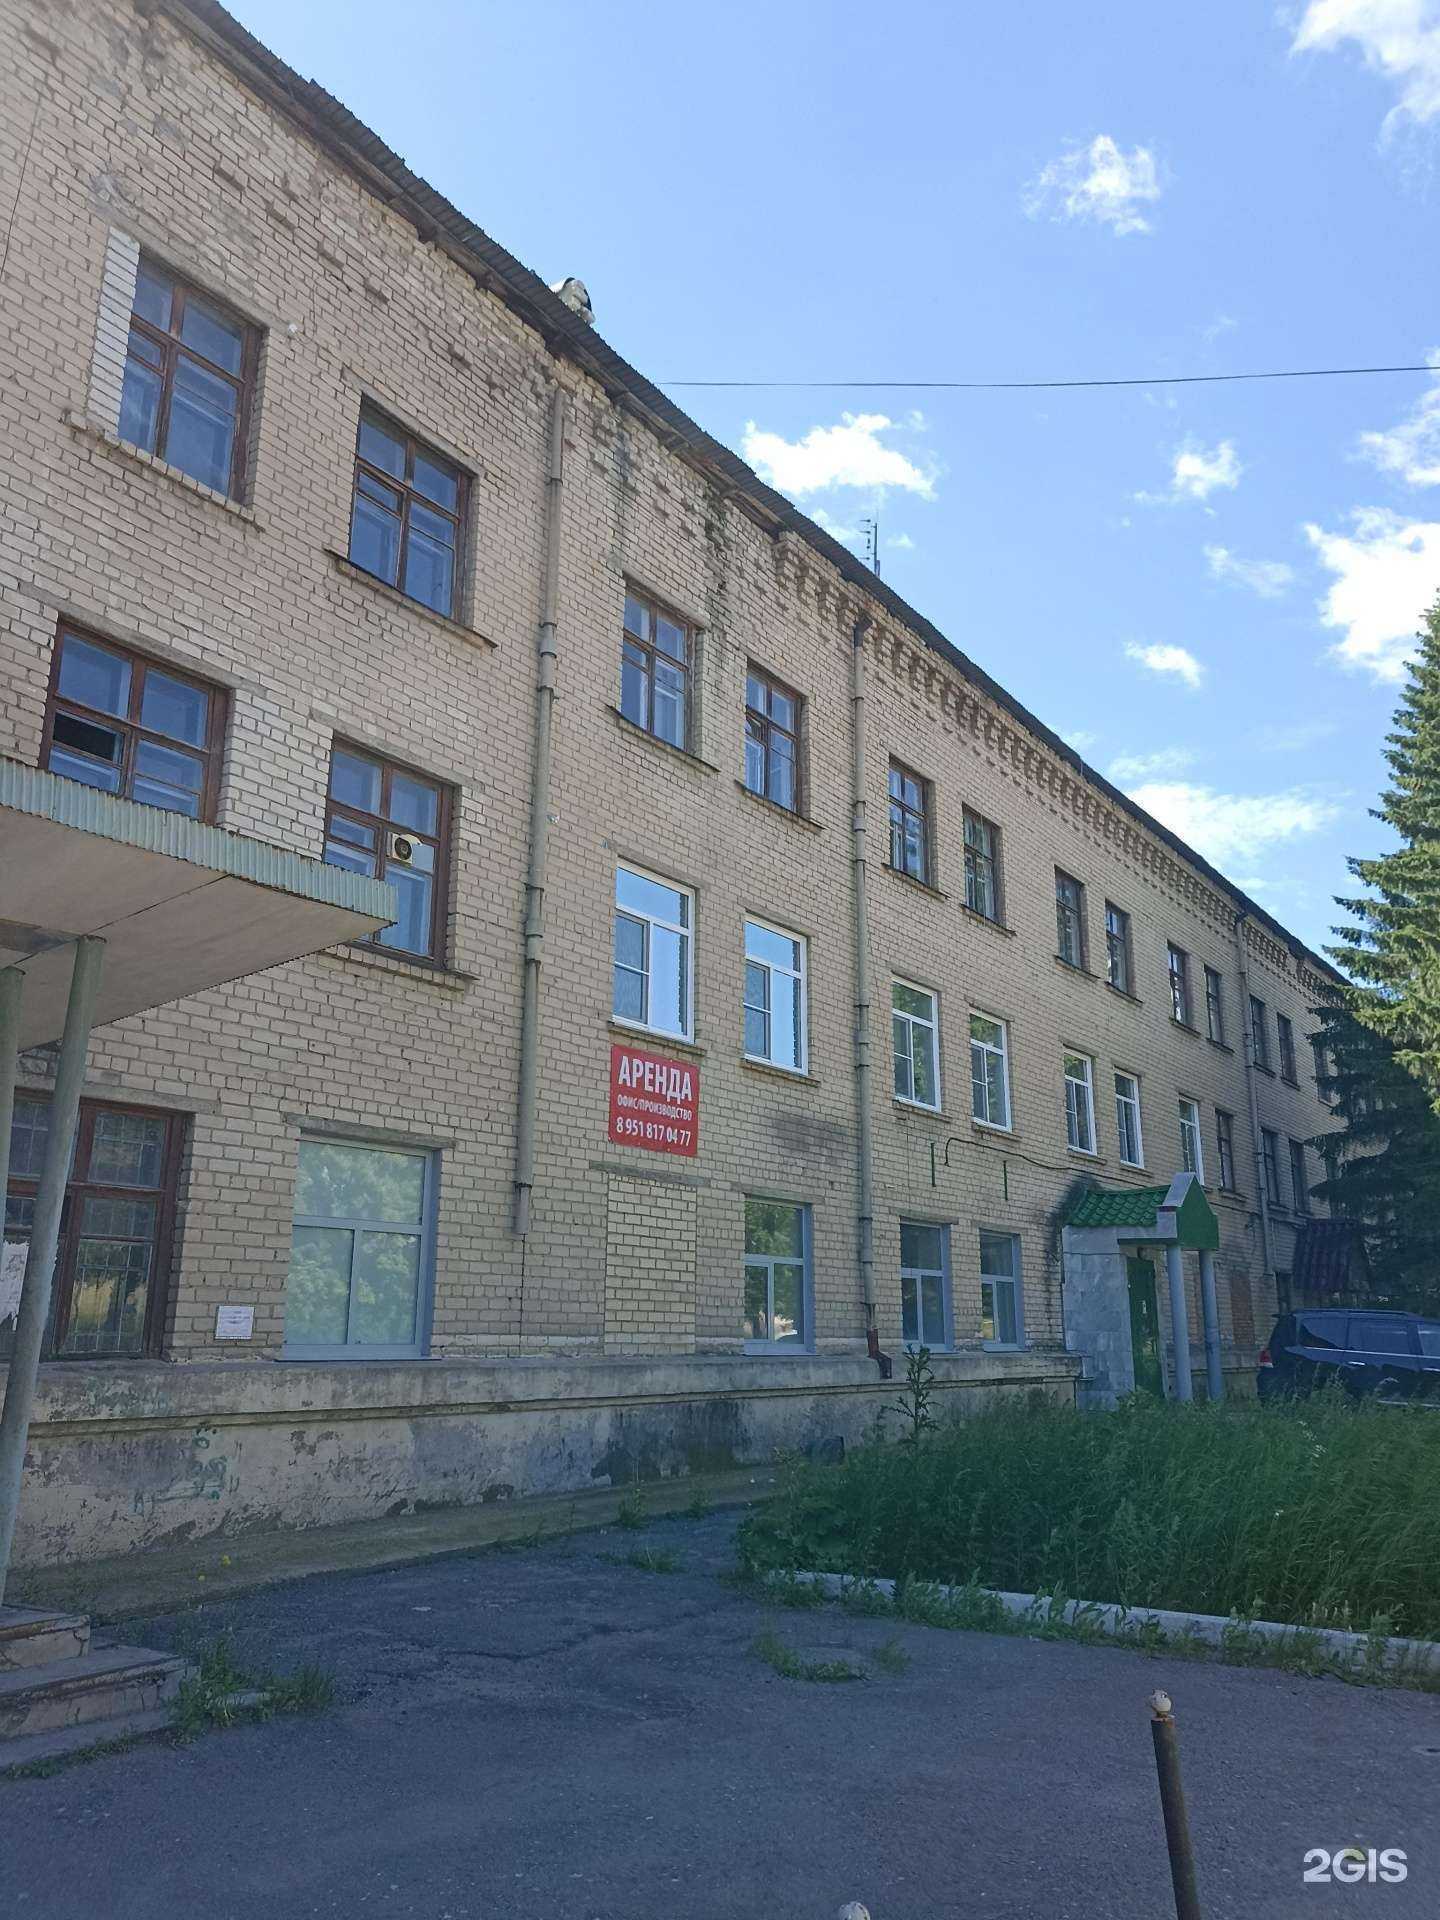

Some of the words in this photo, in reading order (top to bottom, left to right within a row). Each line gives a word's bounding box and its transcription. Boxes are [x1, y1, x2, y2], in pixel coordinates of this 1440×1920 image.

[618, 1056, 692, 1104] АРЕНДА
[616, 1117, 623, 1133] 8
[626, 1119, 643, 1137] 951
[646, 1122, 664, 1140] 817
[680, 1130, 691, 1146] 77
